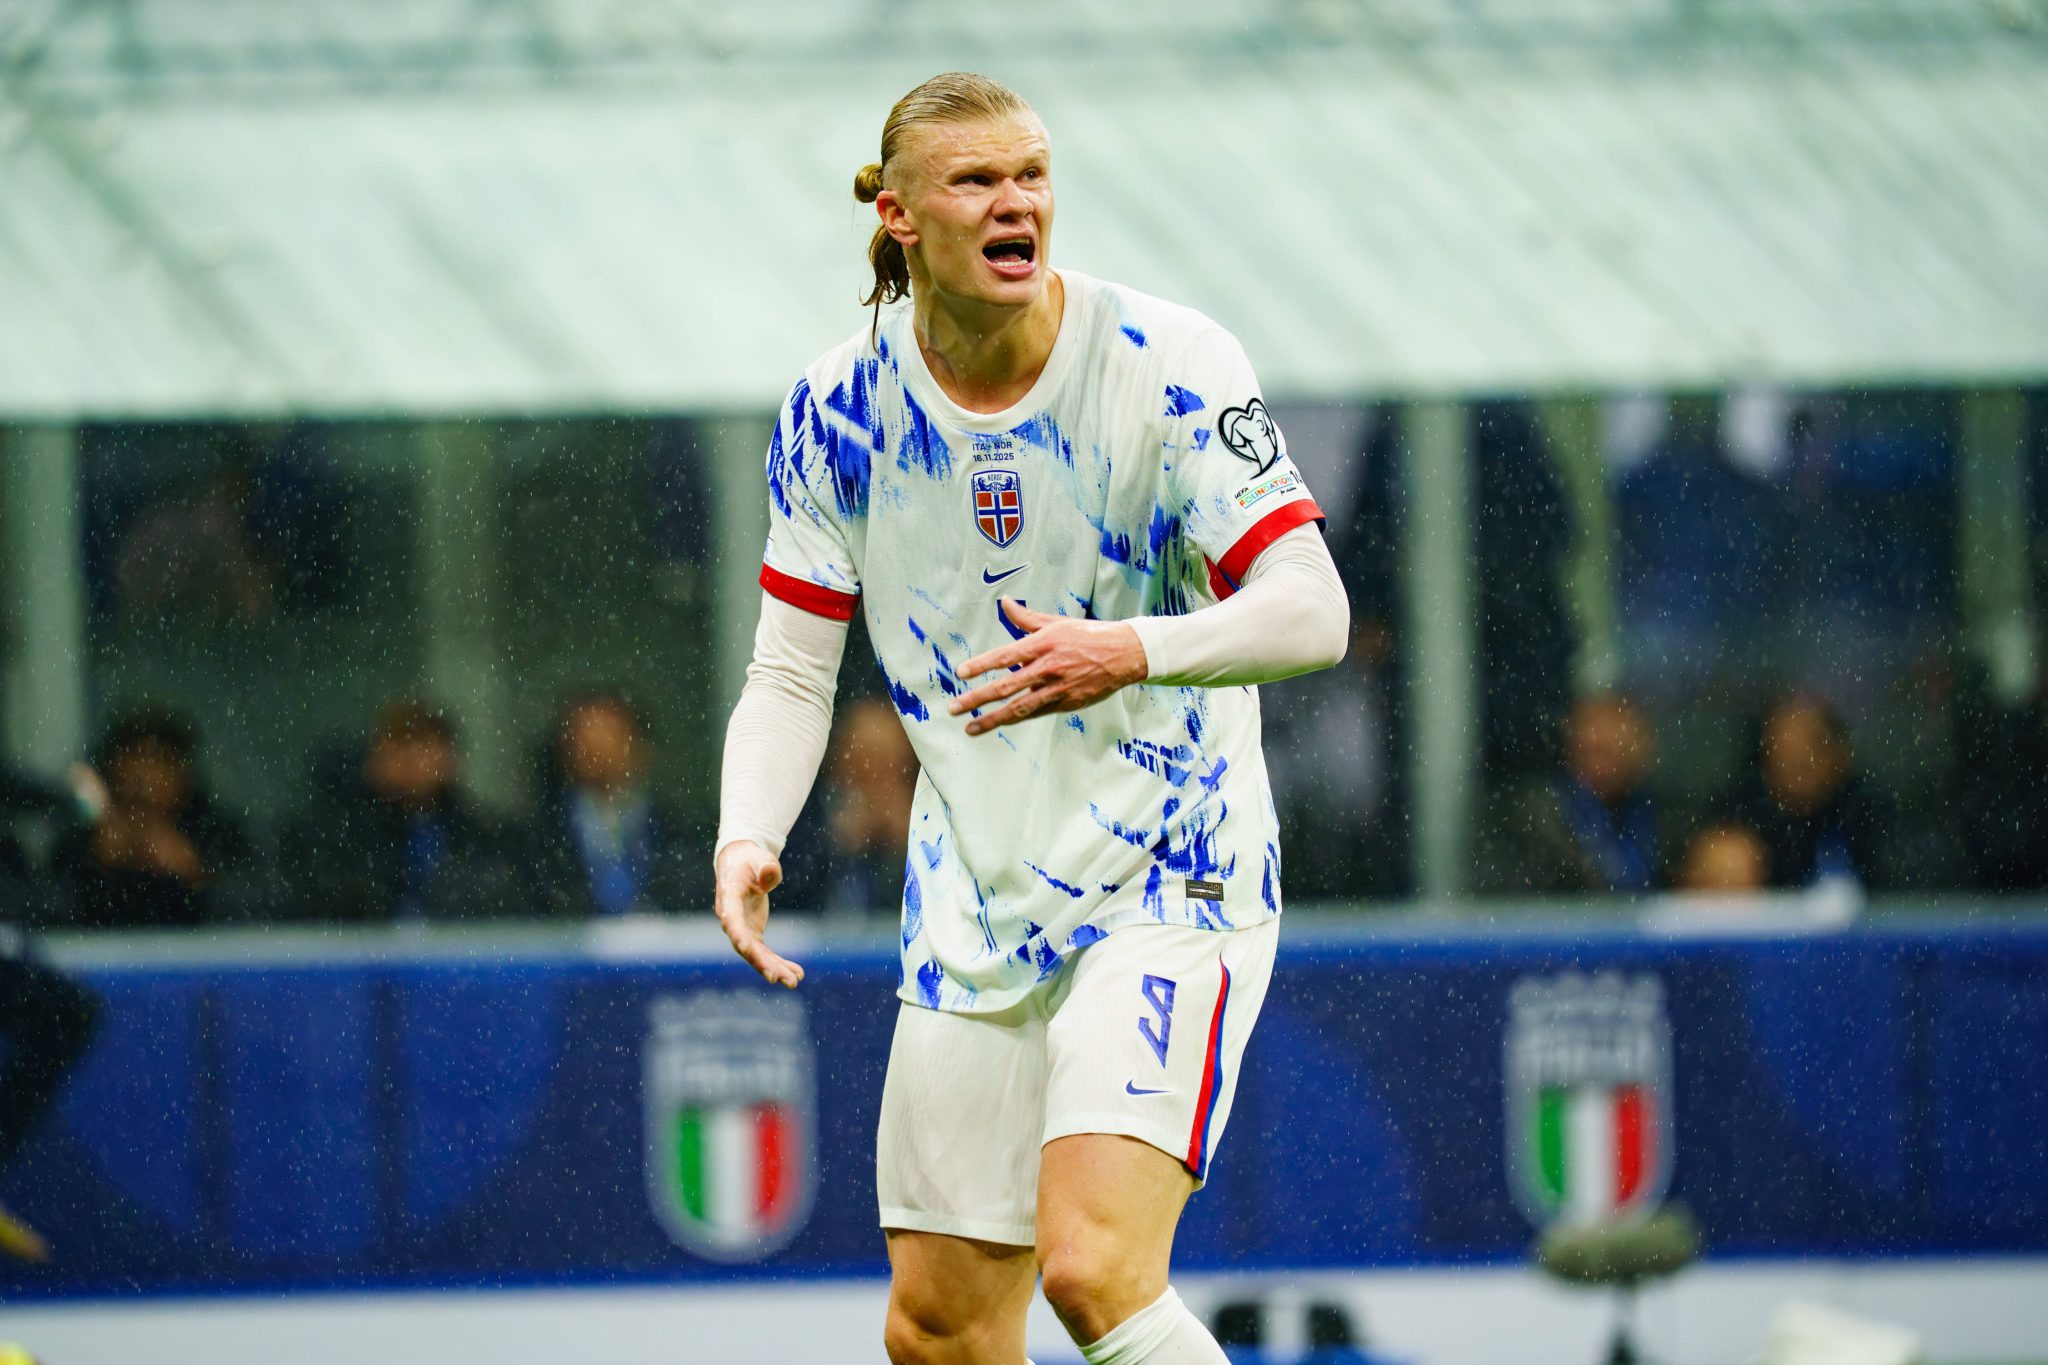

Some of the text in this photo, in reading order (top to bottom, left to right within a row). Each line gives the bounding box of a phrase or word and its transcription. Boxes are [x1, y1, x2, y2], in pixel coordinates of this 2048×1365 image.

[972, 443, 987, 451] ITA
[994, 441, 1013, 450] NOR
[1239, 476, 1292, 507] FOUNDATION
[1138, 974, 1177, 1070] 9
